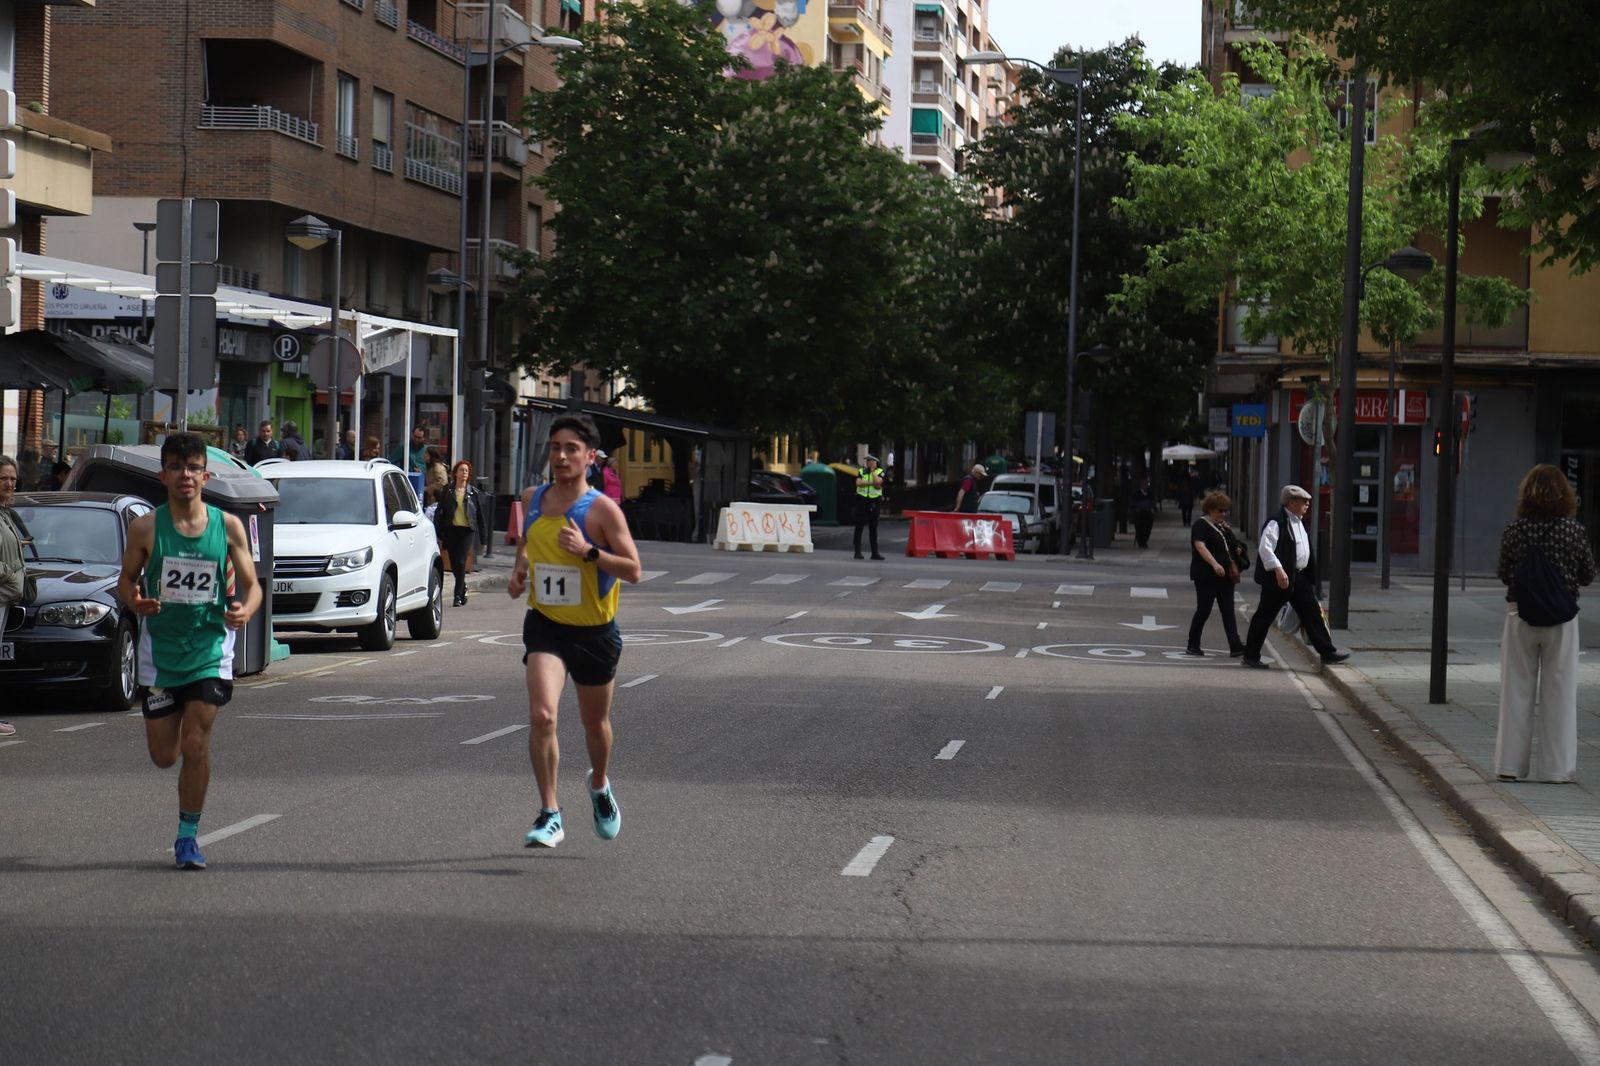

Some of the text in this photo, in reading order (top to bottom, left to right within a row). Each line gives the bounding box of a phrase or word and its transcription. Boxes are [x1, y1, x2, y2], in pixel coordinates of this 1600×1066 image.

[166, 569, 211, 591] 242
[273, 582, 293, 592] JDK
[543, 576, 565, 596] 11
